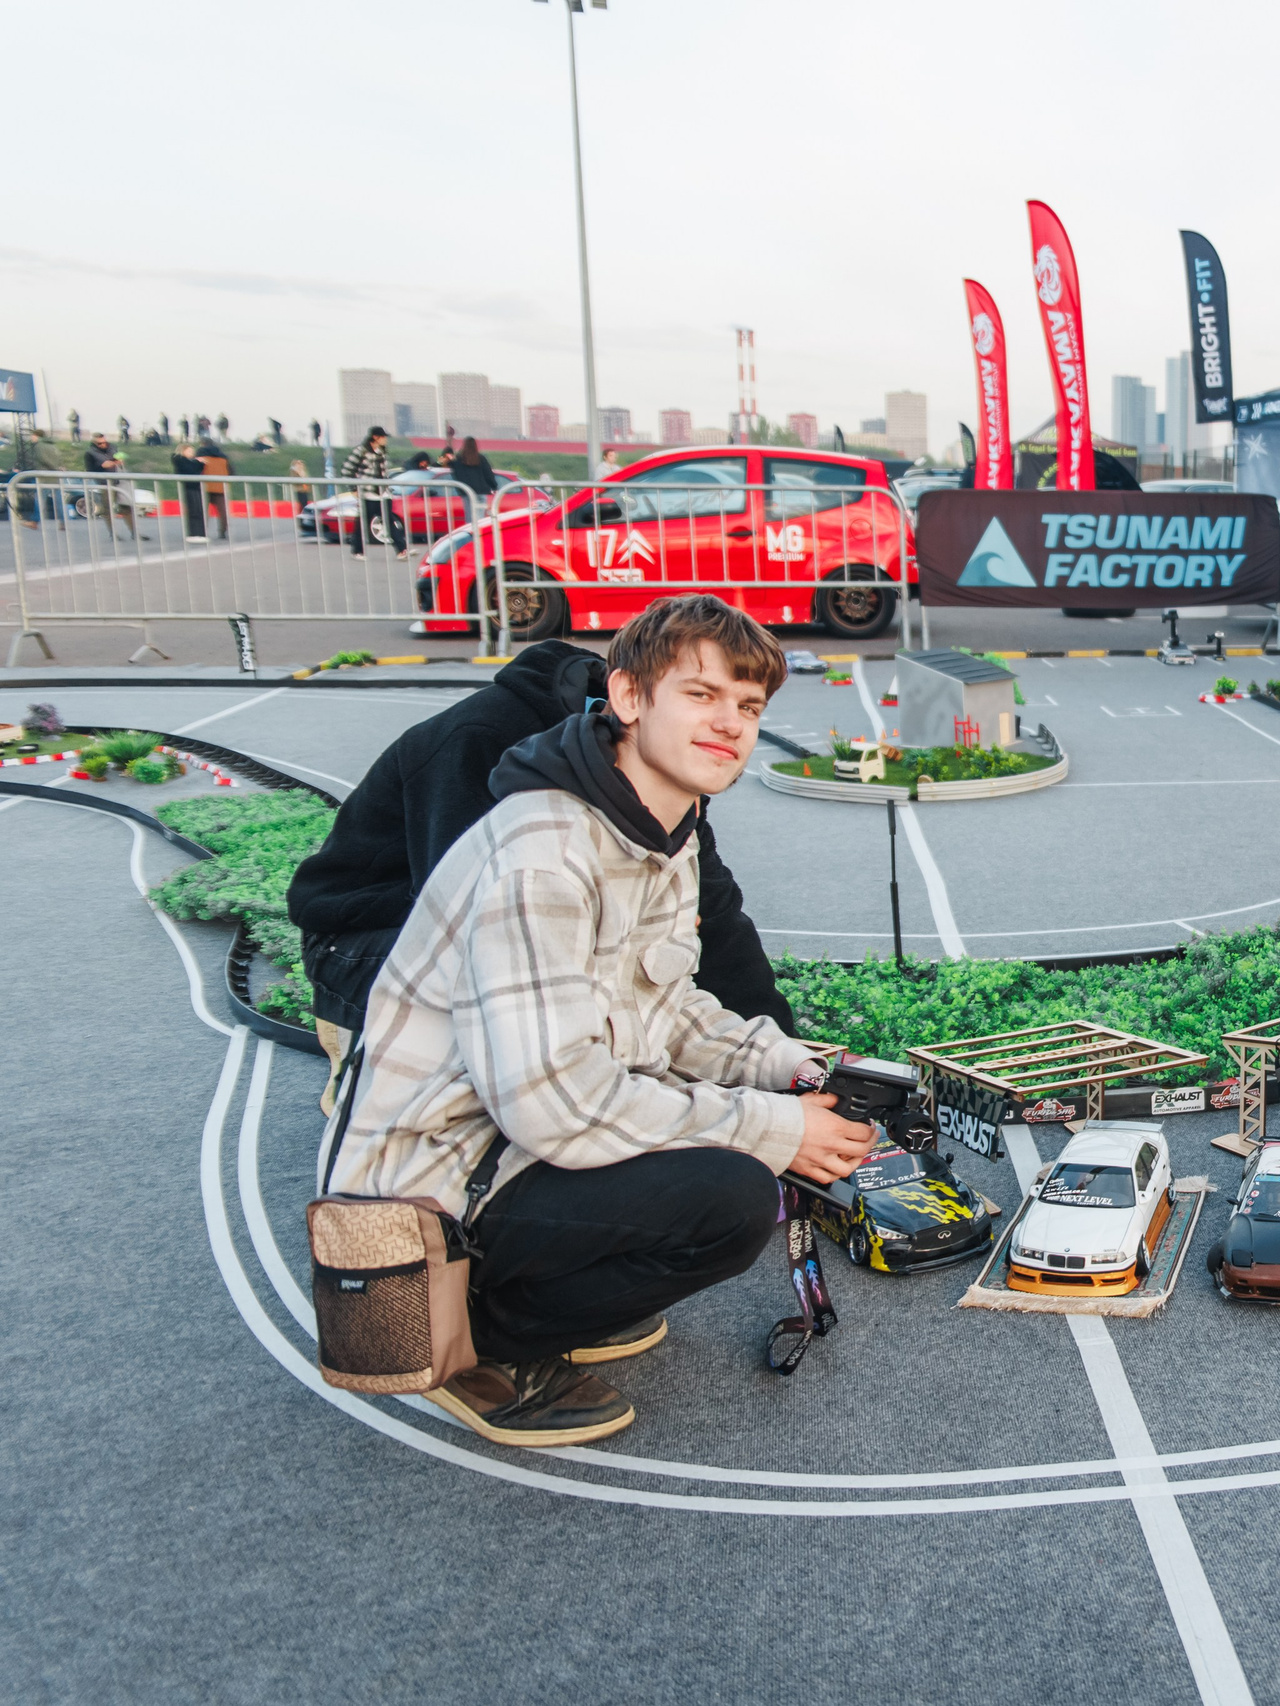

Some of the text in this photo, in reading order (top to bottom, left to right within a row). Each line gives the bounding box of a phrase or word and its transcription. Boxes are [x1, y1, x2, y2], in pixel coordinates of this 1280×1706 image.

[586, 529, 618, 567] 17
[766, 525, 805, 552] MG
[1041, 513, 1247, 551] TSUNAMI
[1043, 553, 1247, 588] FACTORY
[1155, 1091, 1202, 1103] EXHAUST
[937, 1103, 996, 1157] EXHAUST
[1060, 1194, 1085, 1202] NEXT
[1084, 1195, 1113, 1206] LEVEL
